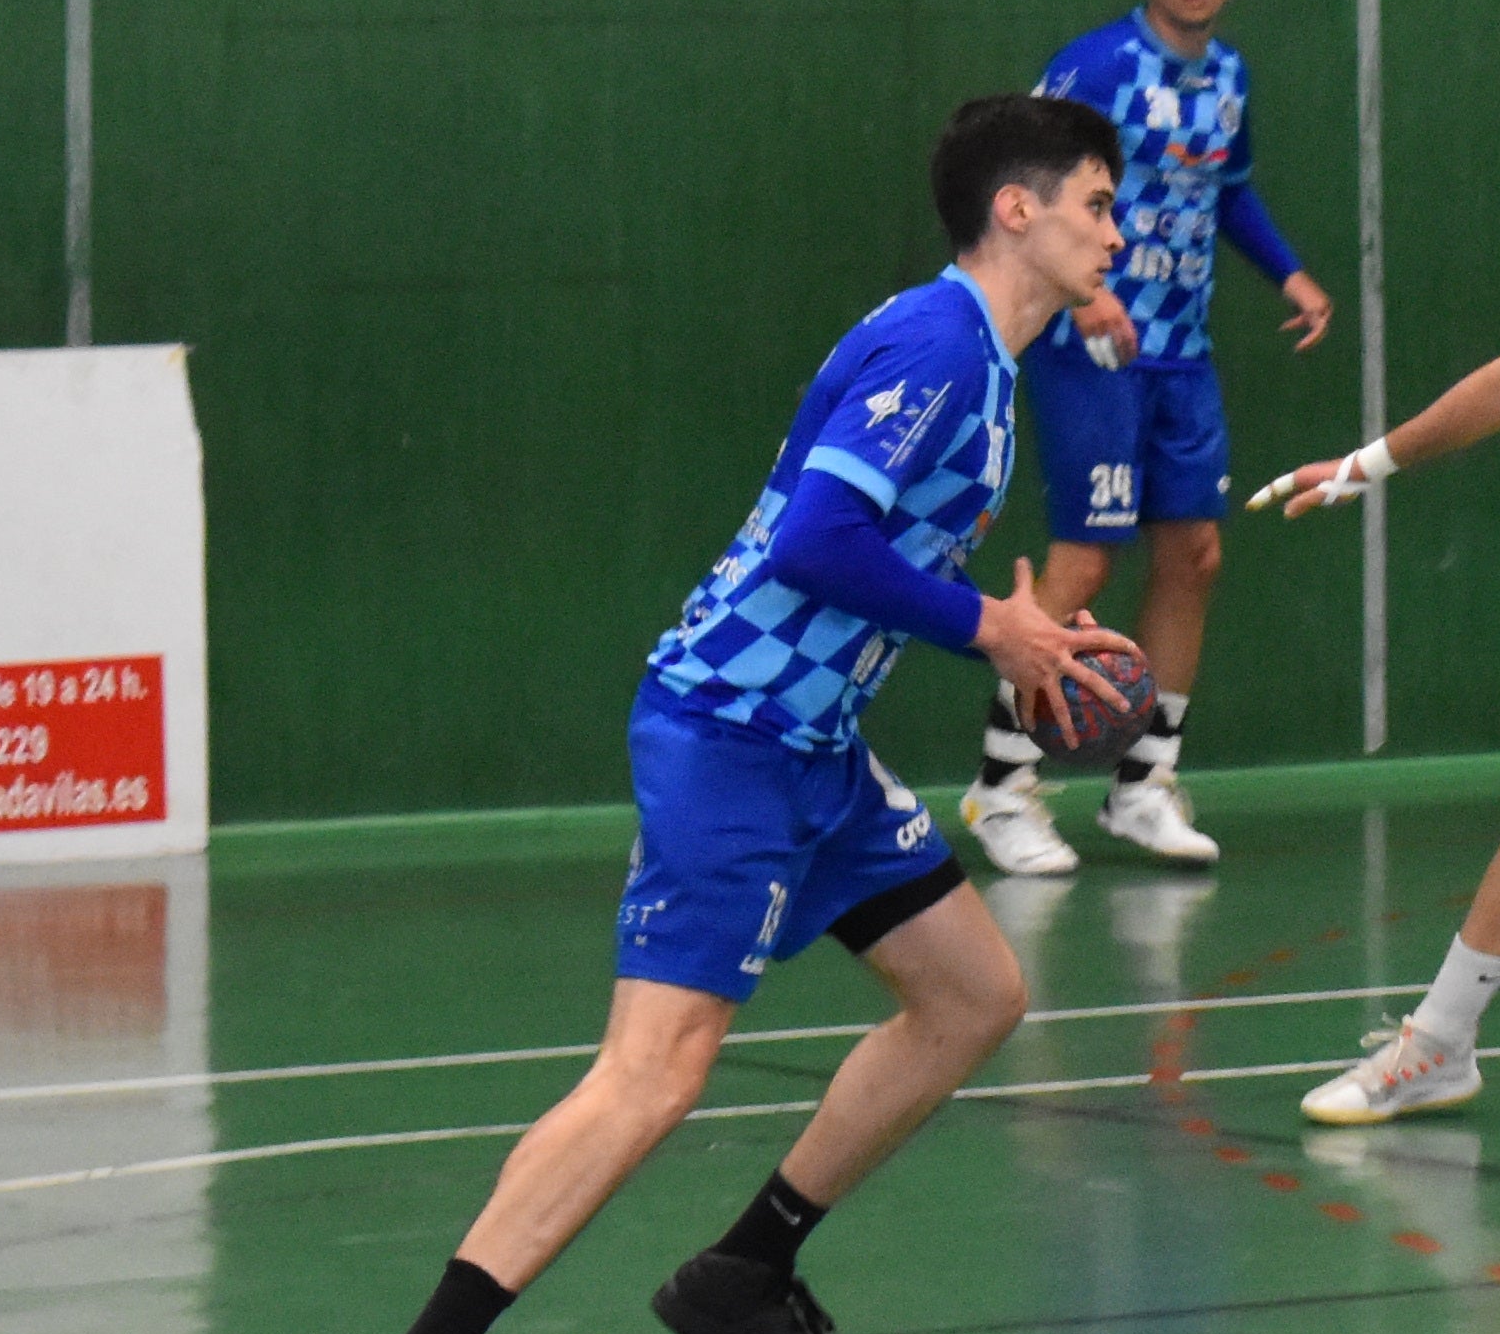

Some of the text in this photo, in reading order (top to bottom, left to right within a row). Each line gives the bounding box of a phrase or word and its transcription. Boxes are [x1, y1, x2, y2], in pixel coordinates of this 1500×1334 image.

[58, 675, 79, 706] a
[83, 666, 118, 704] 24
[120, 665, 150, 703] h.
